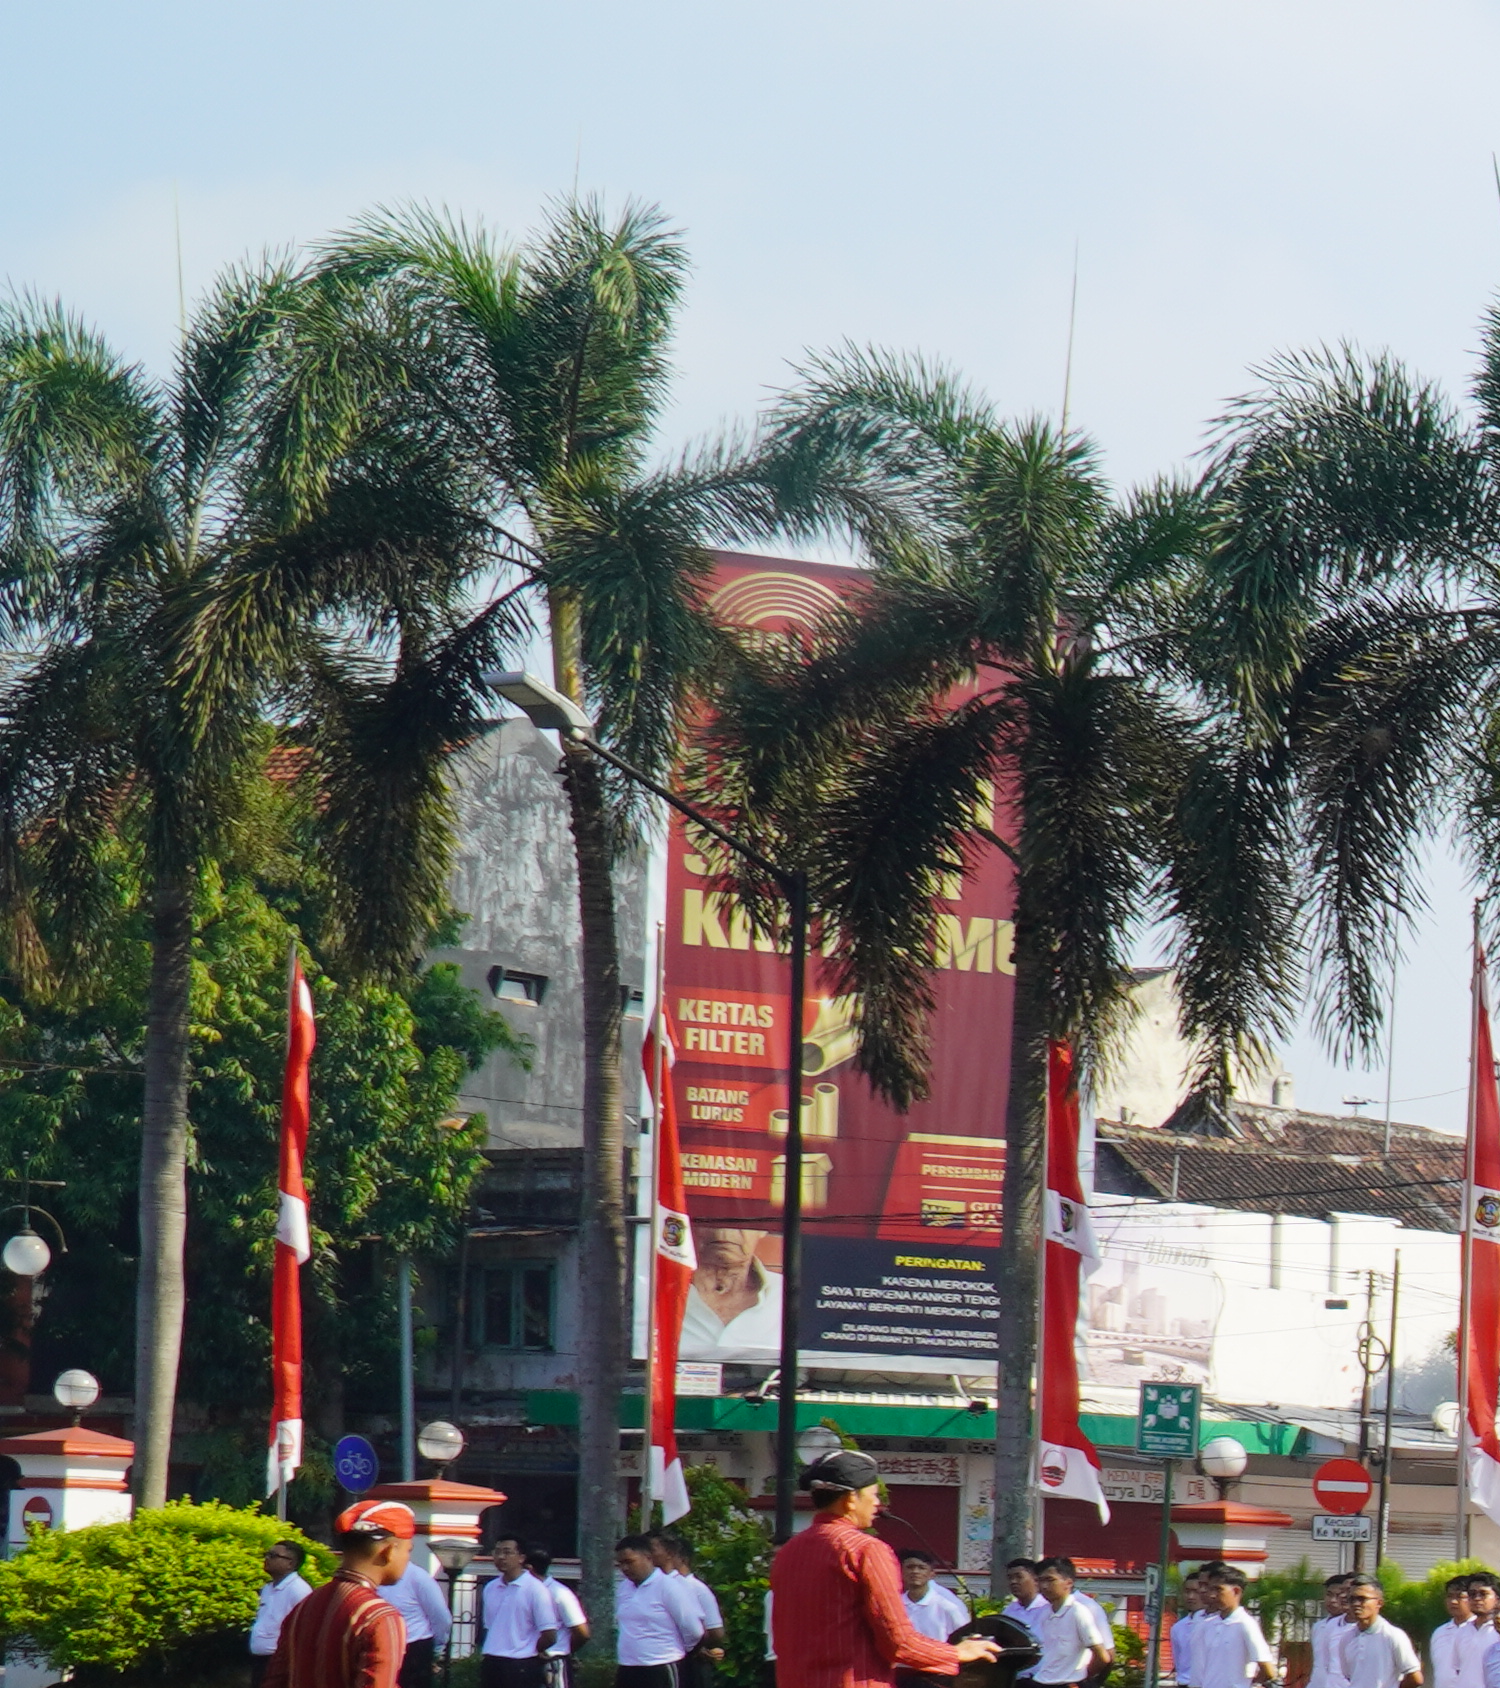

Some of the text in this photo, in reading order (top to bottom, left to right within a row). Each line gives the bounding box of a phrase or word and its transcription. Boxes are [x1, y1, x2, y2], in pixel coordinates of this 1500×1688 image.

[679, 997, 774, 1028] KERTAS
[686, 1028, 765, 1056] FILTER
[686, 1086, 750, 1106] BATANG
[691, 1105, 744, 1123] LURUS
[679, 1153, 757, 1172] KEMASAN
[682, 1171, 752, 1190] MODERN
[895, 1255, 987, 1272] PERINGATAN:
[881, 1276, 933, 1289] KARENA
[821, 1285, 853, 1297] SAYA
[855, 1287, 912, 1301] TERKENA
[912, 1291, 962, 1304] KANKER
[816, 1299, 866, 1311] LAYANAN
[867, 1302, 924, 1315] BERHENTI
[924, 1306, 980, 1318] MEROKOK
[1101, 1485, 1136, 1500] urya
[1140, 1484, 1176, 1501] Djaa
[1316, 1527, 1368, 1540] Ke Masjid
